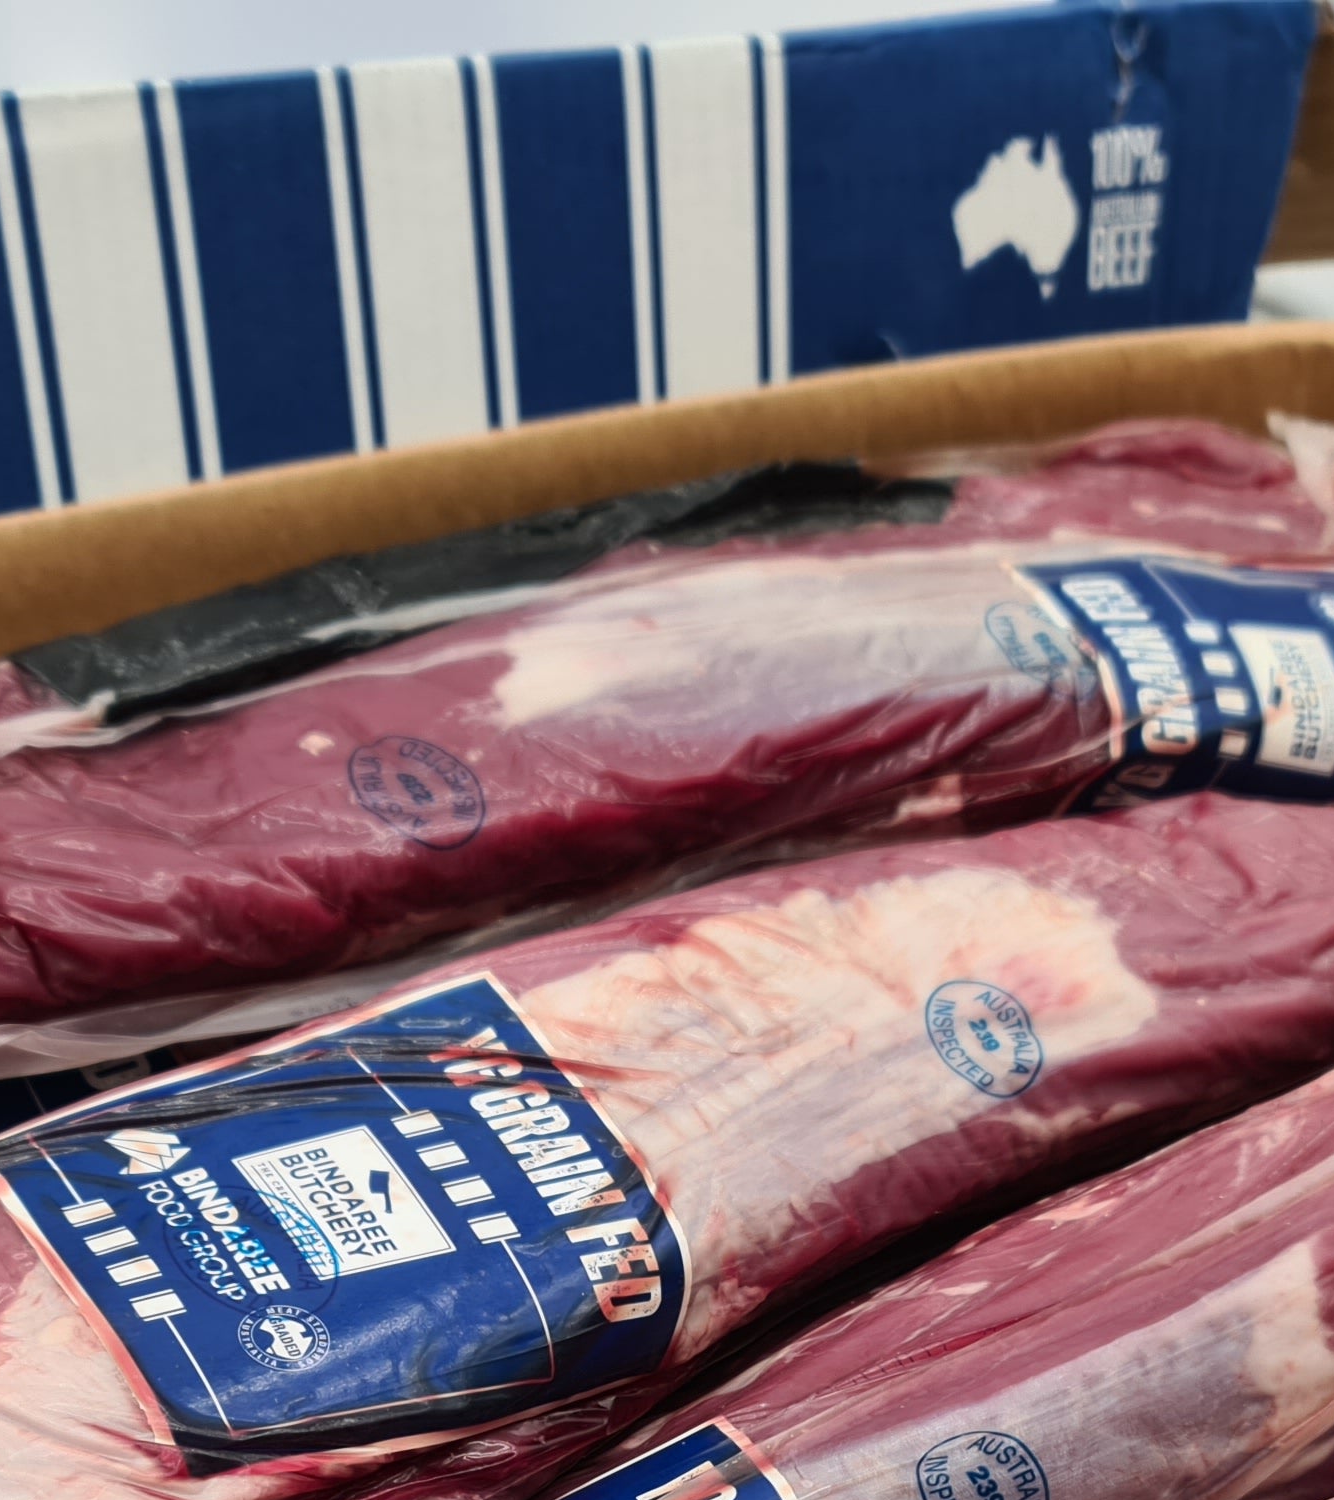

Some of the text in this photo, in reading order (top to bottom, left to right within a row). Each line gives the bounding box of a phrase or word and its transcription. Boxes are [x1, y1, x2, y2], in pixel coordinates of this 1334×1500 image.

[1103, 627, 1199, 755] GRAIN
[932, 998, 995, 1087] INSPECTED
[974, 990, 1034, 1075] AUSTRALIA
[138, 1180, 194, 1228] FOOD
[180, 1230, 247, 1301] GROUP
[172, 1167, 291, 1296] BINDAREE
[279, 1153, 374, 1257] BUTCHERY
[304, 1147, 398, 1255] BINDAREE
[470, 1080, 626, 1217] GRAIN
[565, 1217, 662, 1323] FED
[240, 1318, 277, 1367] AUSTRALIA
[269, 1317, 302, 1357] GRADED
